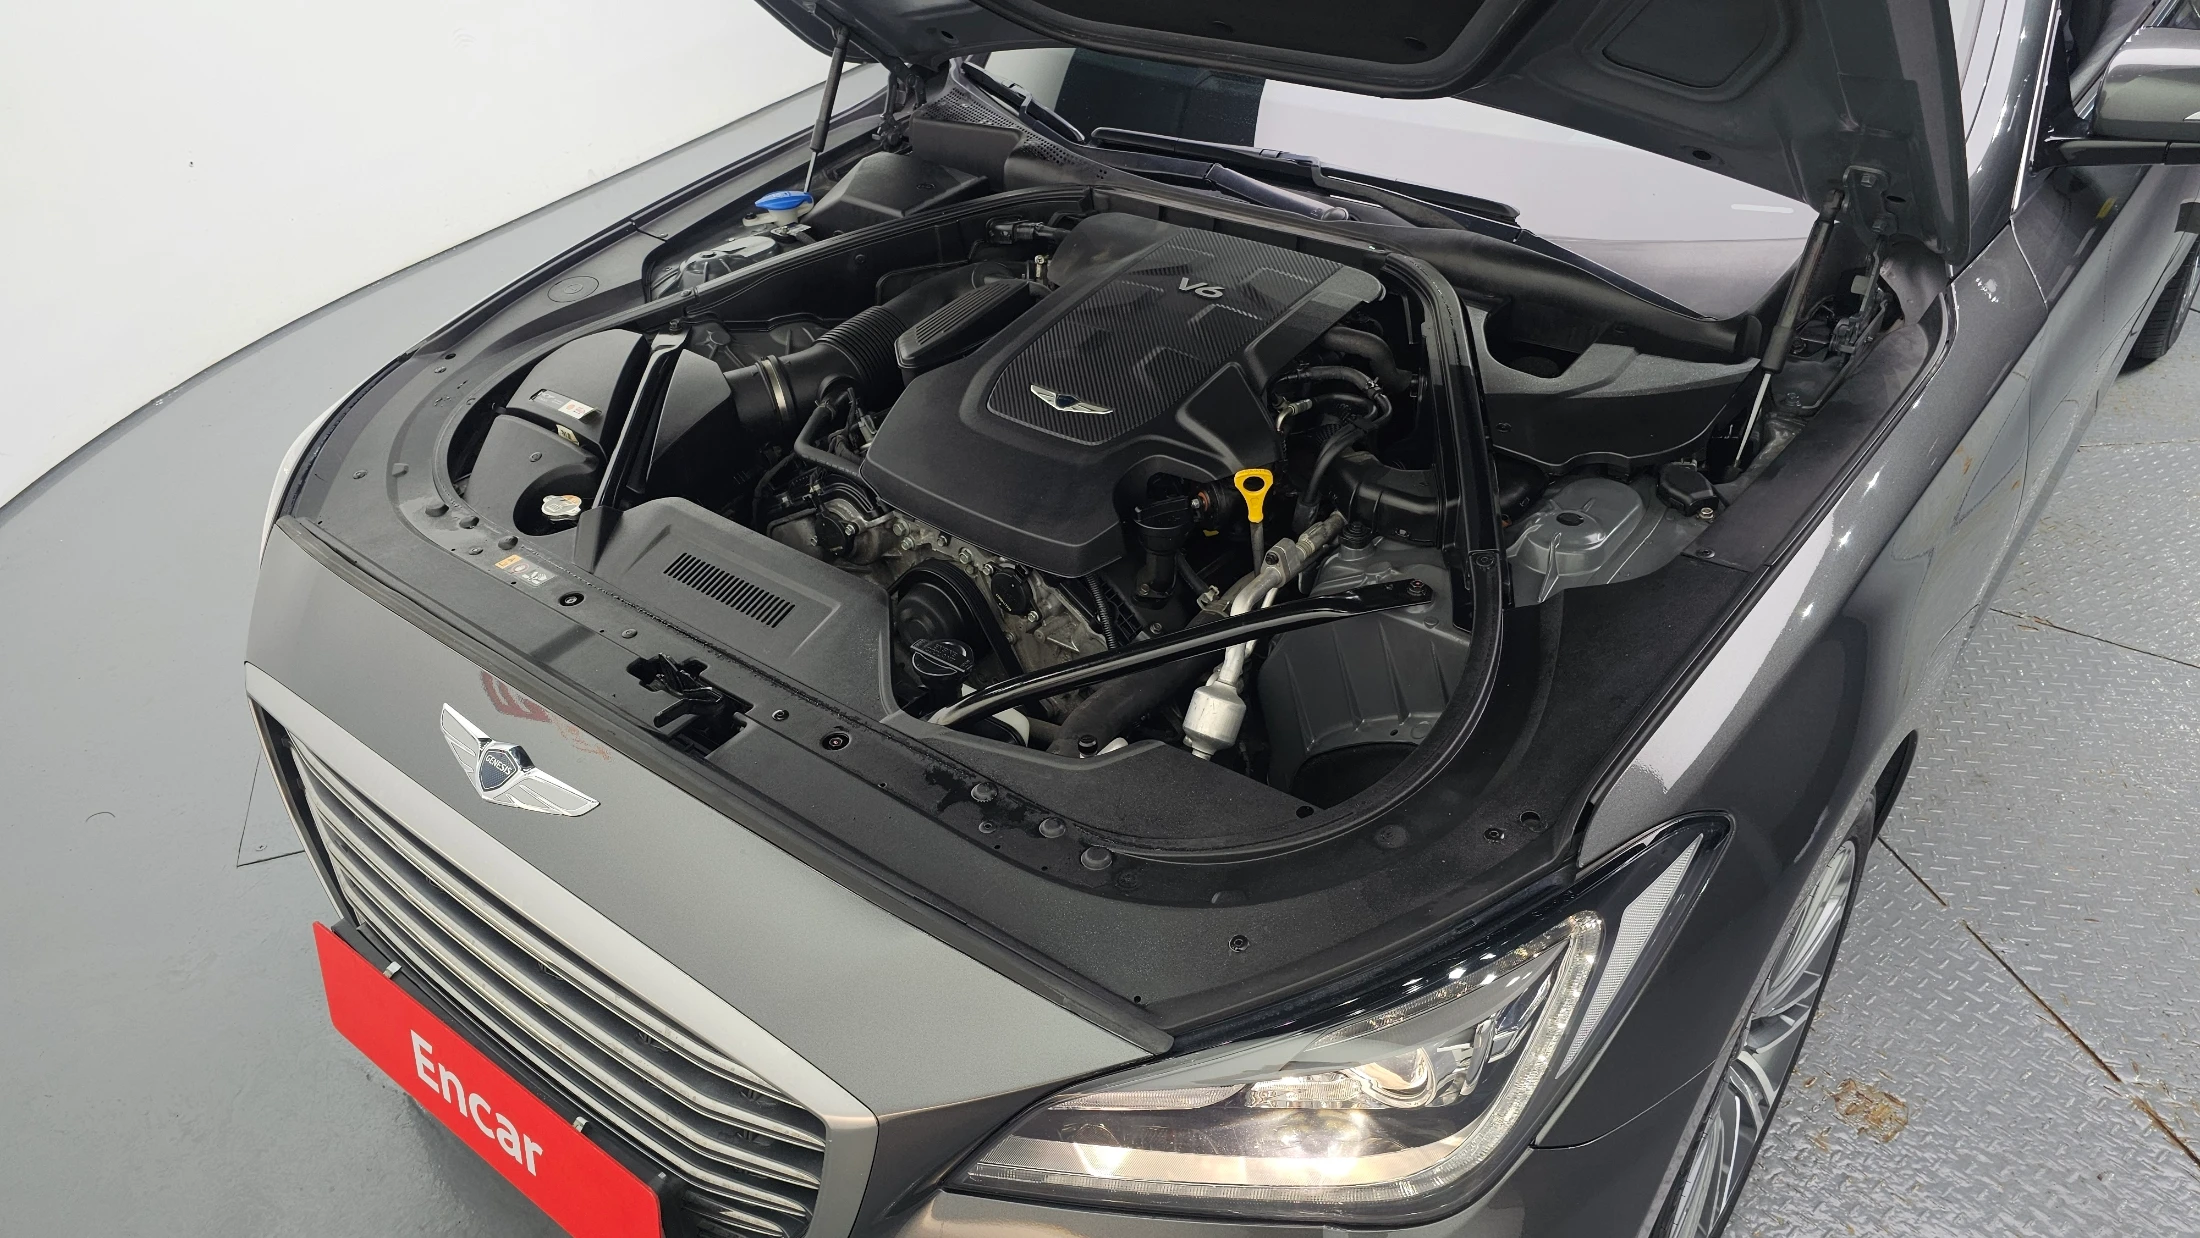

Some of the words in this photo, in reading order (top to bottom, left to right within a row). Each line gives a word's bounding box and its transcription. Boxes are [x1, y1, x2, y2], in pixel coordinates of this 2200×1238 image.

[1179, 277, 1225, 298] V6
[485, 754, 513, 775] GENESIS
[410, 1029, 544, 1177] Encar
